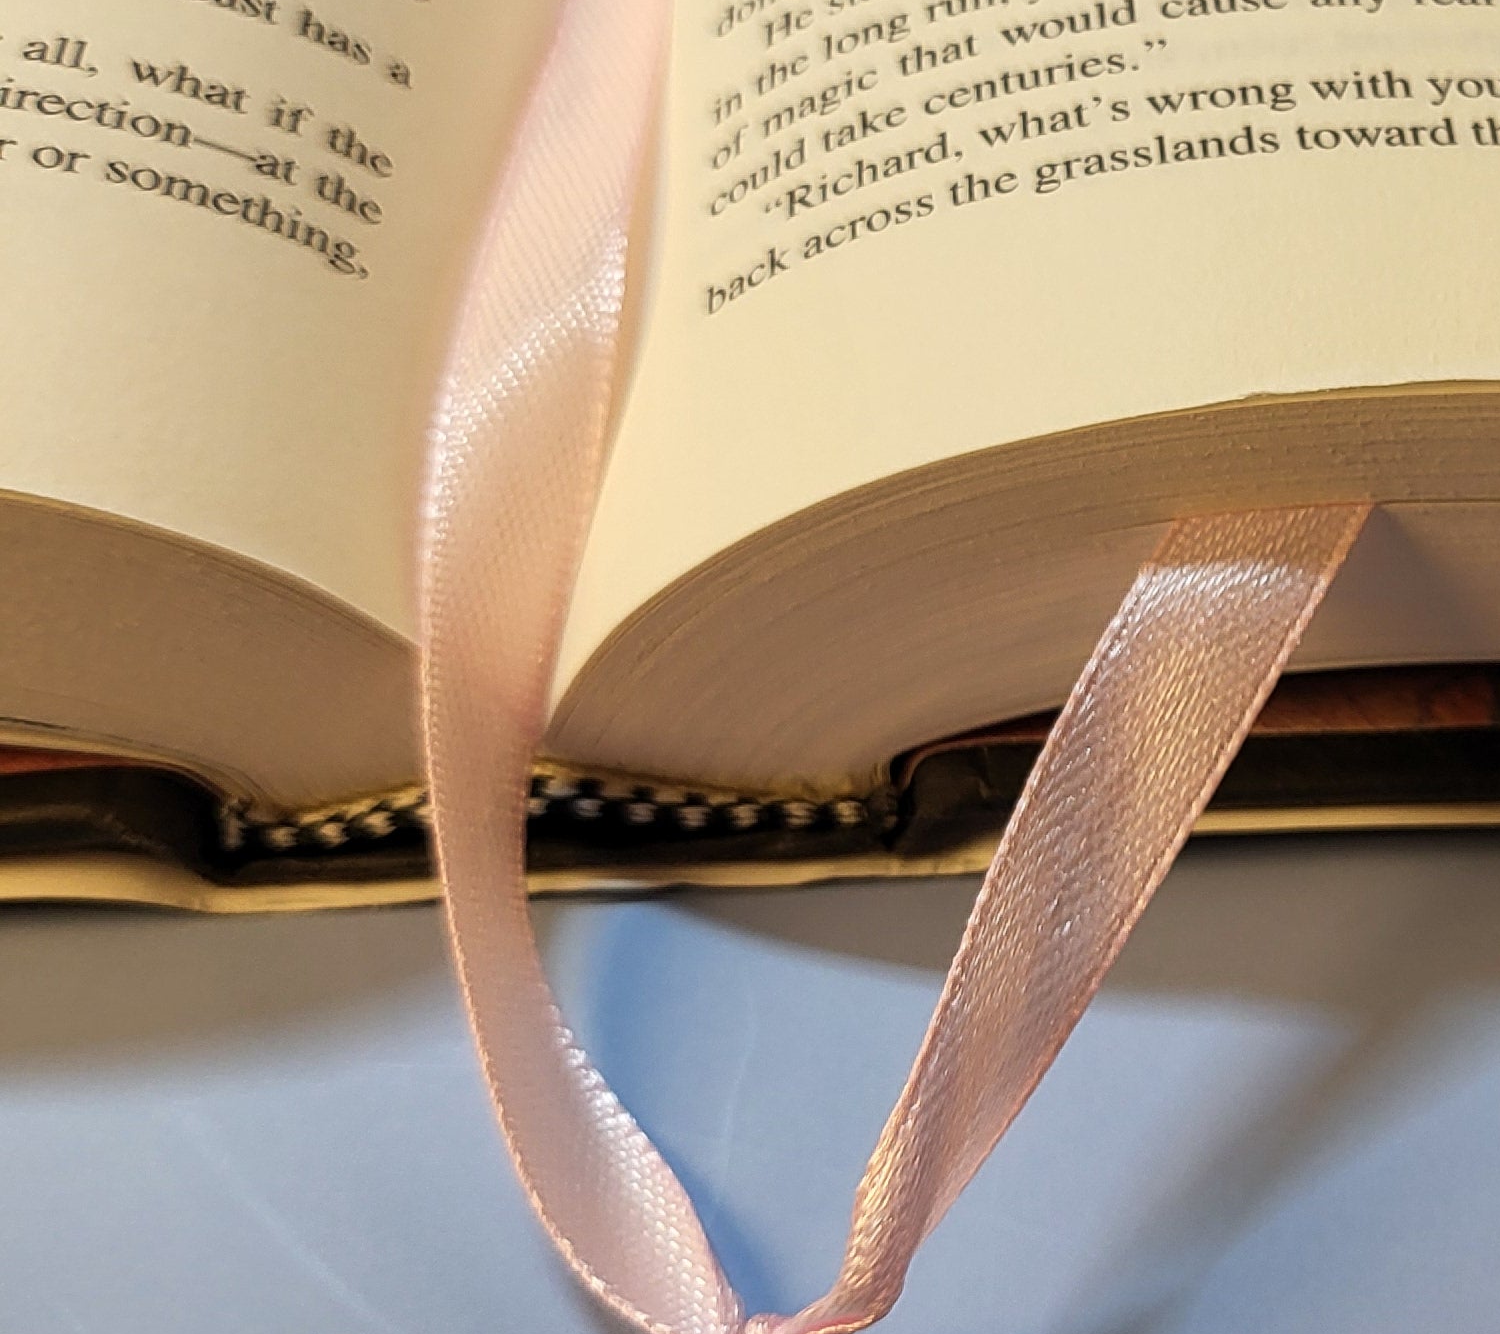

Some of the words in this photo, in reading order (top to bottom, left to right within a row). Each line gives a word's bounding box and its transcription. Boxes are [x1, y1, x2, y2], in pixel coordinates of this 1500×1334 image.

[297, 7, 371, 66] has
[385, 59, 411, 90] a
[711, 91, 742, 126] in
[755, 53, 809, 96] the
[822, 11, 910, 61] long
[763, 8, 813, 47] He
[21, 35, 98, 78] all,
[130, 59, 246, 115] what
[268, 97, 313, 136] if
[325, 125, 392, 179] the
[709, 126, 744, 170] of
[761, 68, 878, 138] magic
[897, 33, 976, 77] that
[709, 136, 806, 217] could
[821, 105, 906, 153] take
[923, 38, 1167, 116] centuries."
[978, 95, 1130, 147] what's
[1146, 81, 1296, 115] wrong
[1309, 69, 1413, 100] with
[29, 145, 89, 174] or
[103, 159, 366, 280] something,
[313, 172, 382, 226] the
[706, 246, 788, 315] back
[803, 193, 934, 260] across
[949, 171, 1018, 207] the
[1035, 123, 1280, 195] grasslands
[1295, 115, 1458, 150] toward
